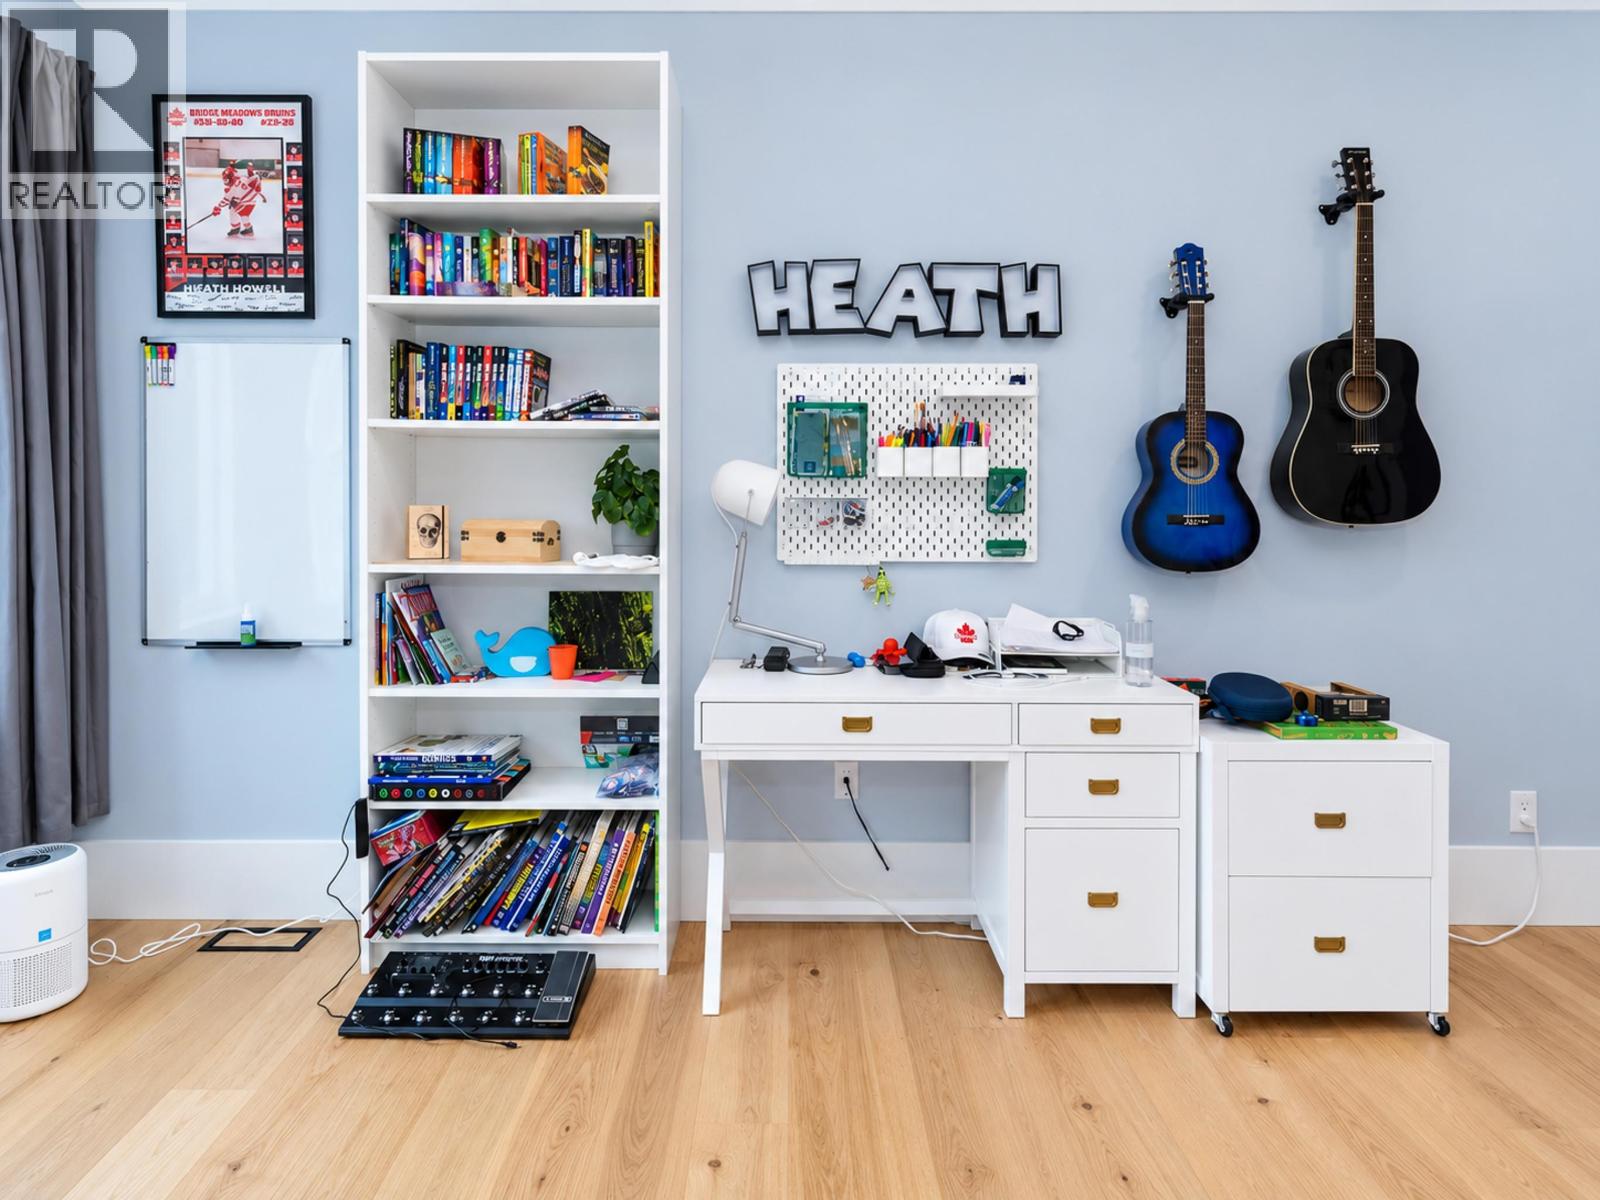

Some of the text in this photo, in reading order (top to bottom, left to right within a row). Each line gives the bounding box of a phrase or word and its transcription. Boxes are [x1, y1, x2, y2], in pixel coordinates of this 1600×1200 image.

[189, 108, 296, 117] BRIDGE MEADOWS BRUINS
[183, 284, 286, 293] HEATH HOWELL
[747, 258, 1063, 338] HEATH
